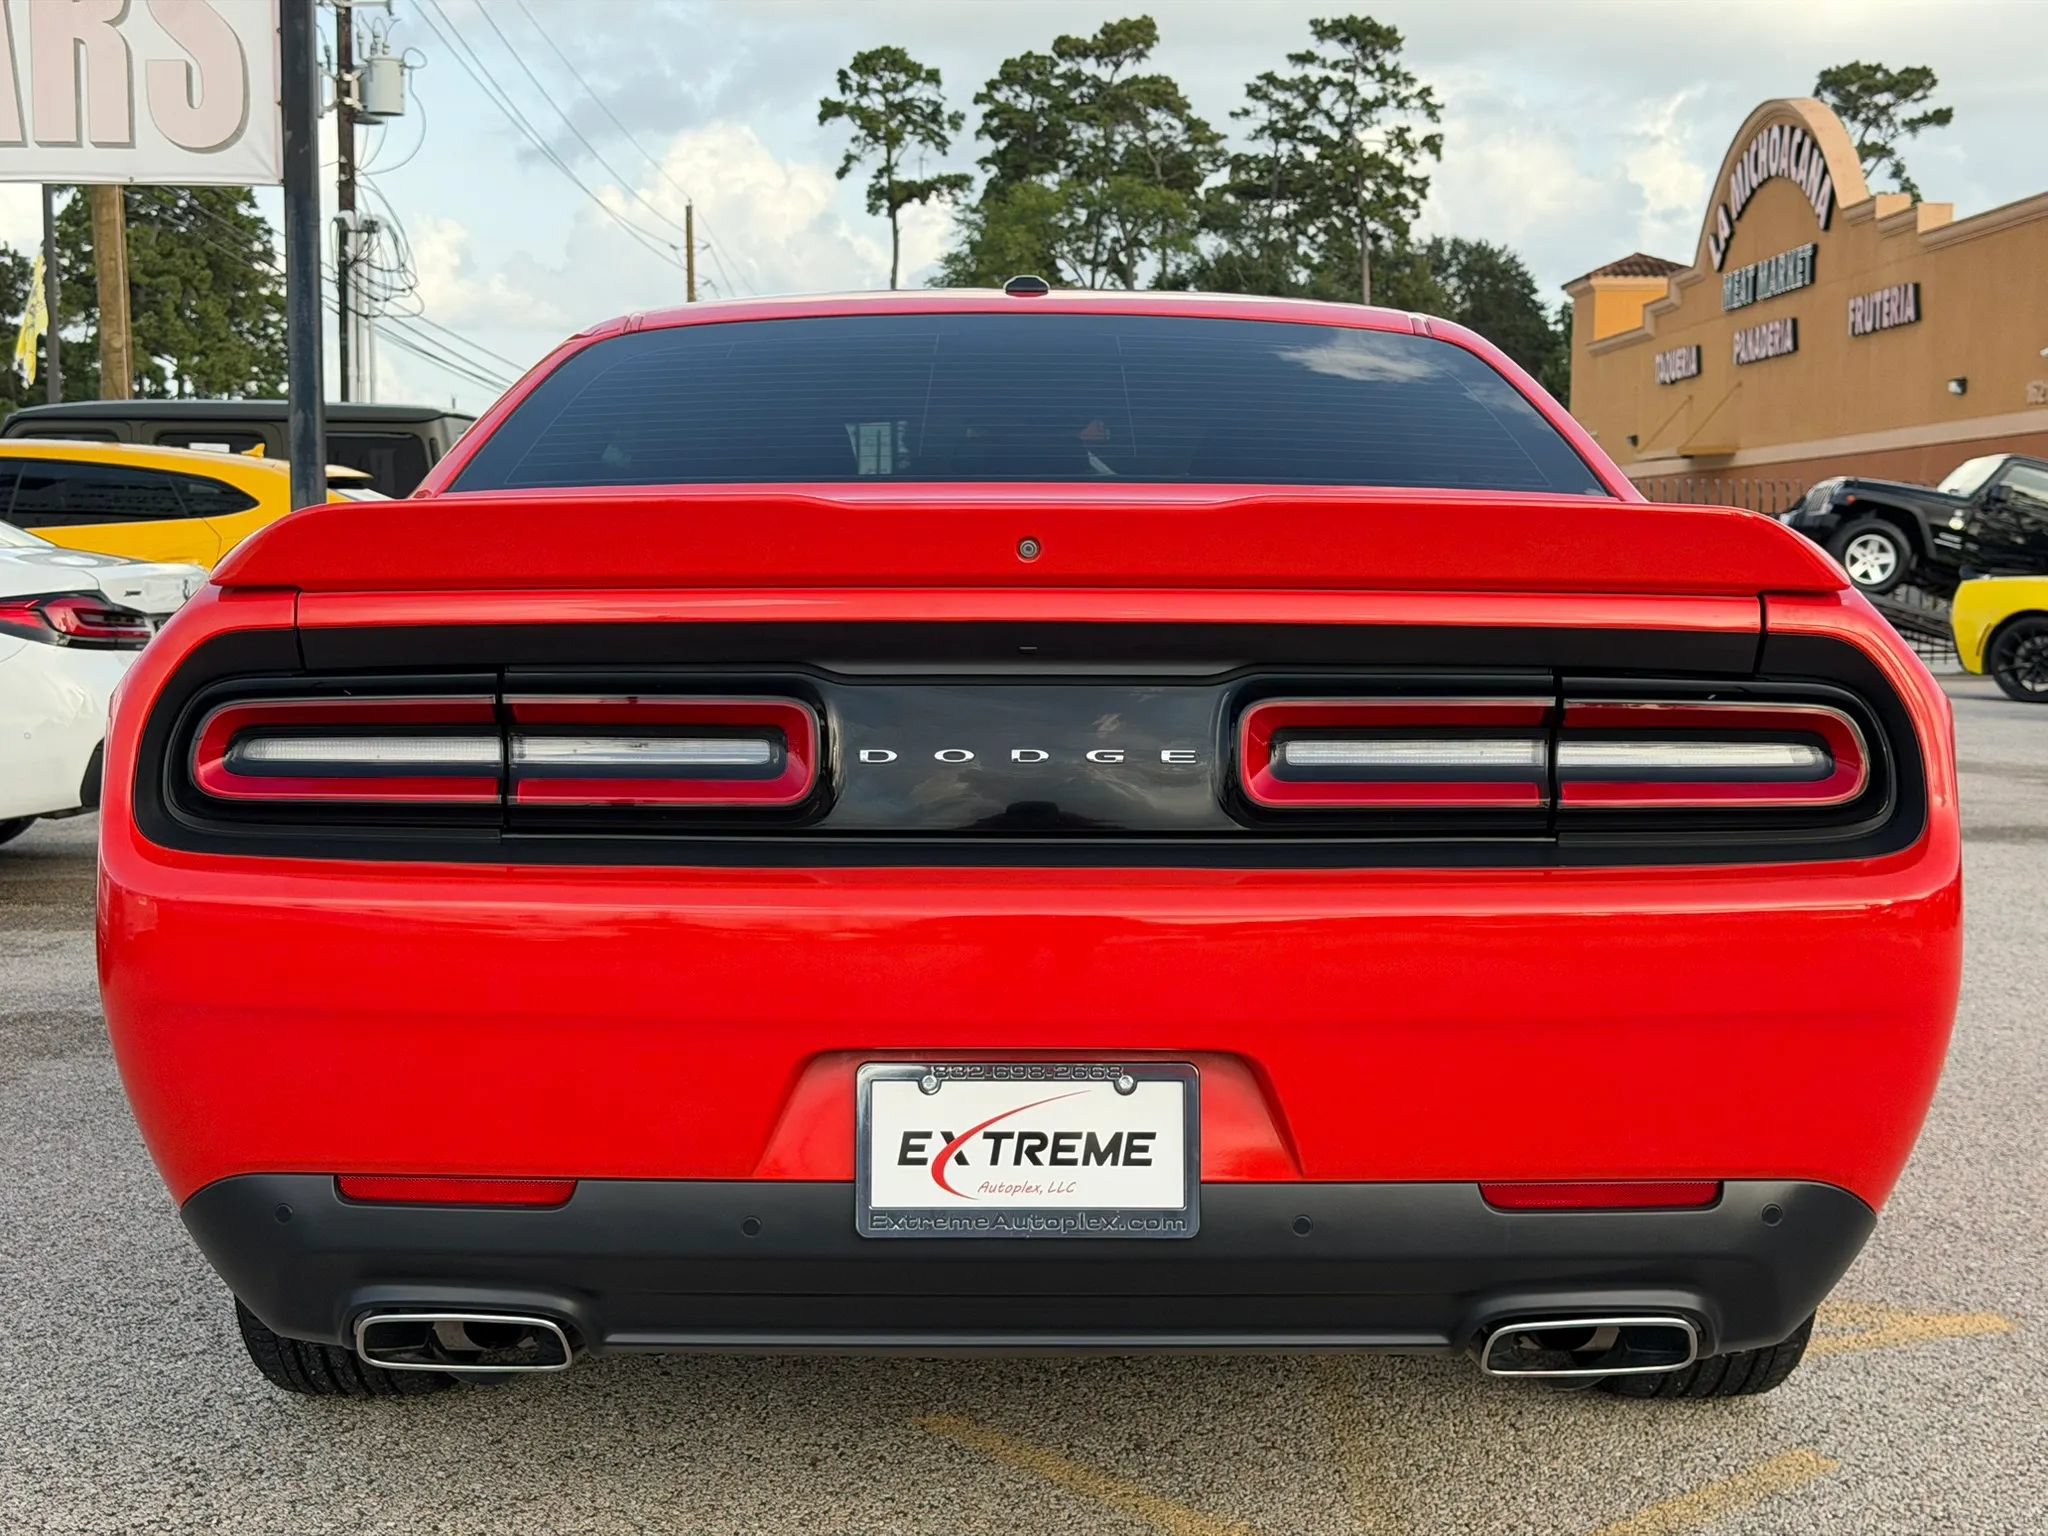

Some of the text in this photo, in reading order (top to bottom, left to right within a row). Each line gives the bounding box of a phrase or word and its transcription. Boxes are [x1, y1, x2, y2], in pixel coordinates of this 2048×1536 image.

[1708, 124, 1836, 272] LA MICHOACANA
[1722, 242, 1818, 311] MEAT MARKET
[1848, 282, 1921, 337] FRUTERIA
[1733, 318, 1797, 364] PANADERIA
[859, 749, 1196, 764] DODGE
[932, 1065, 1124, 1080] 832-698-2668
[897, 1131, 1157, 1167] EXTREME
[977, 1180, 1077, 1196] Autoplex, LLC
[868, 1212, 1187, 1233] ExtremeAutoplex.com
